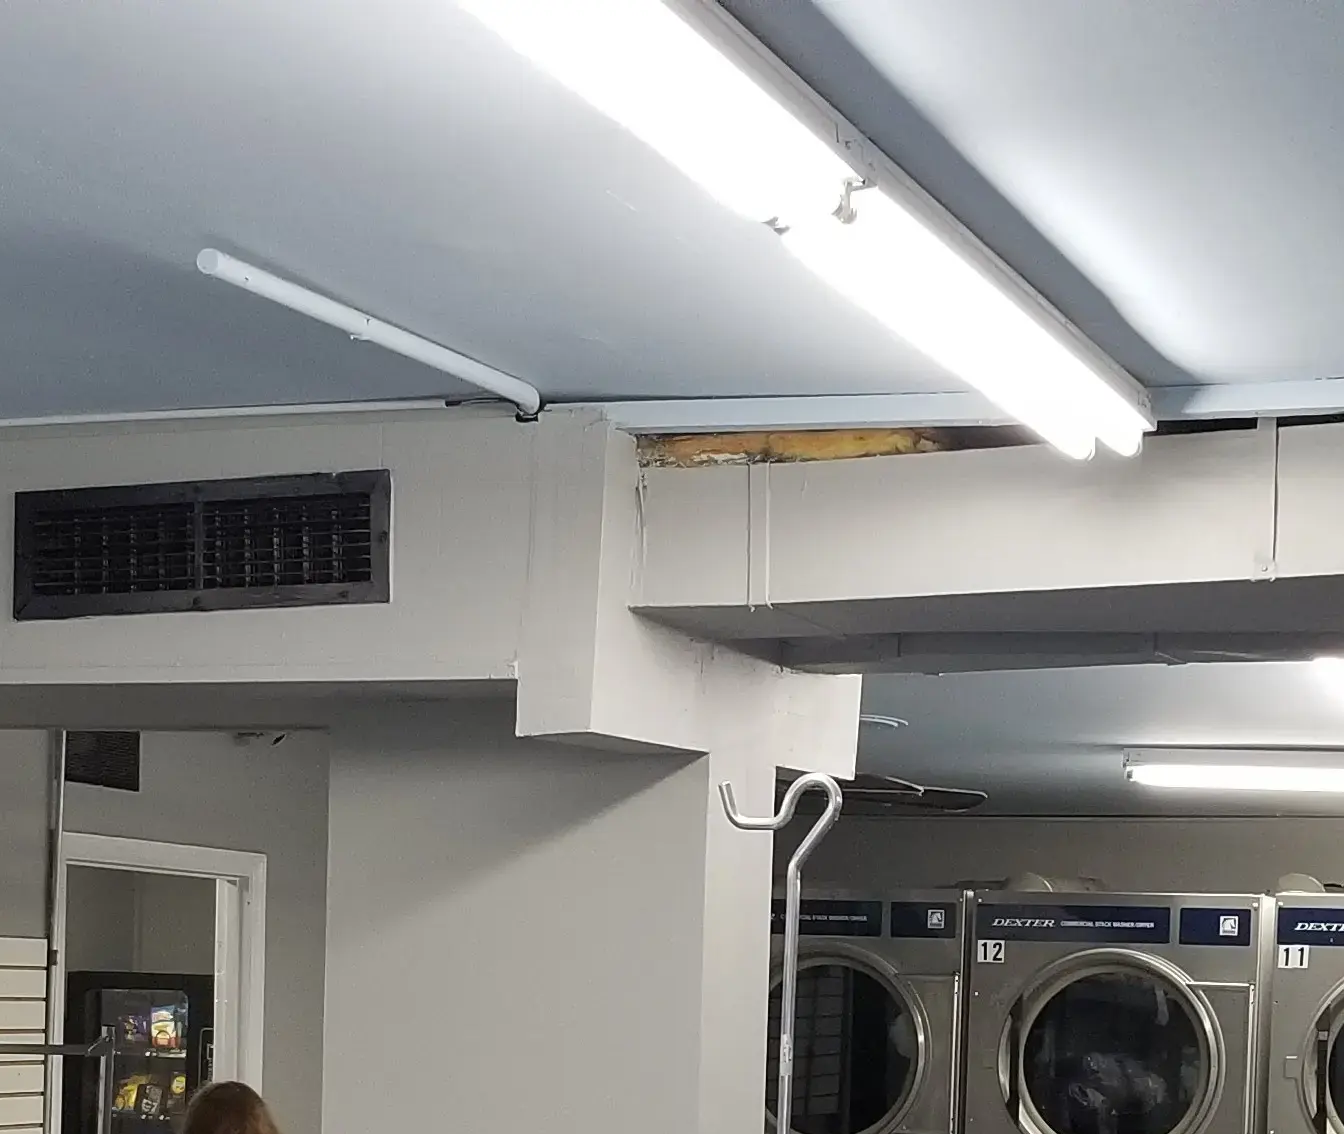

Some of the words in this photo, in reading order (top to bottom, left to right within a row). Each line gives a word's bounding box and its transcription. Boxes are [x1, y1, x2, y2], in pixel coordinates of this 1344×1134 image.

[992, 918, 1056, 928] DEXTER
[980, 942, 1003, 962] 12
[1283, 947, 1305, 966] 11
